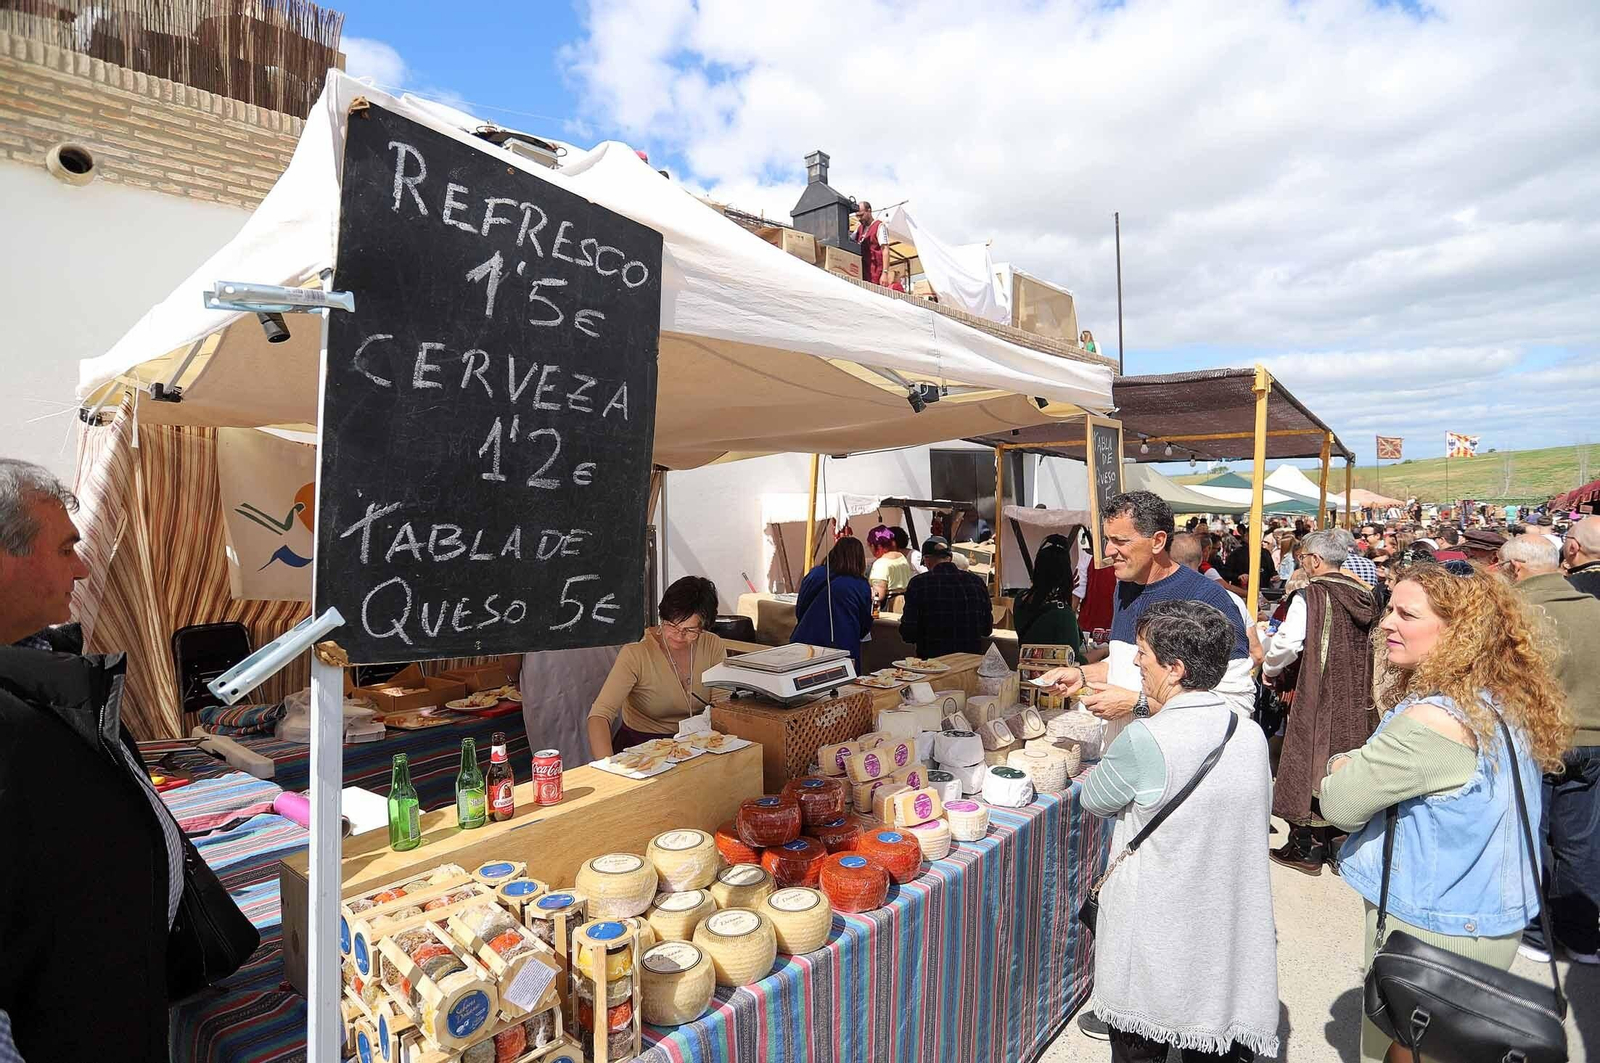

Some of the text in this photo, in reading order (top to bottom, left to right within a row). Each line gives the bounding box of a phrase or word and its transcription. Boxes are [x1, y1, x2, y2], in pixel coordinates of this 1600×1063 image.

[387, 140, 649, 289] REFRESCO
[353, 332, 629, 421] CERVEZA
[1102, 452, 1113, 465] DE
[340, 500, 594, 565] TABLA DE
[361, 575, 527, 646] QUESO
